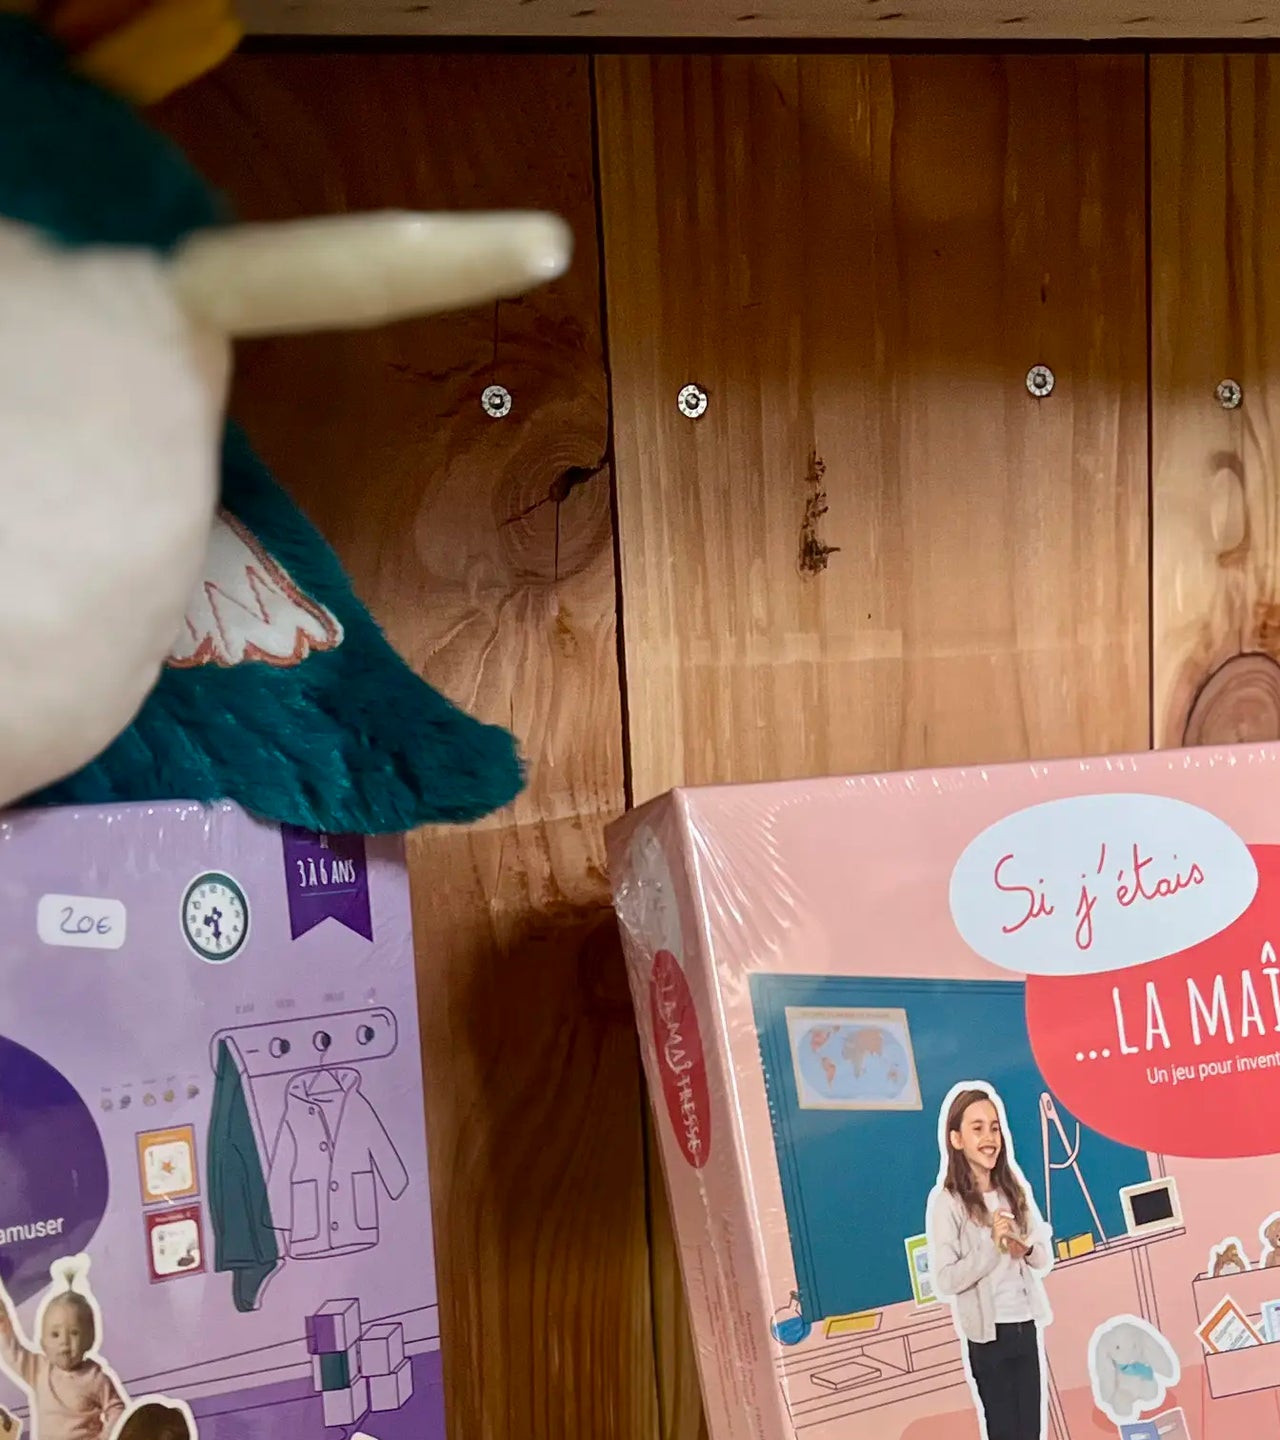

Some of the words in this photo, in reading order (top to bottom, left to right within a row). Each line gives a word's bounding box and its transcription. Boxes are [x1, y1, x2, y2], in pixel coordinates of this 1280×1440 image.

[296, 859, 307, 888] 3
[306, 857, 319, 887] À
[319, 857, 329, 886] 6
[331, 859, 357, 885] ANS
[993, 854, 1054, 933] Si
[1075, 842, 1205, 950] j'étais
[1146, 1065, 1169, 1085] Un
[1171, 1061, 1196, 1083] jeu
[1198, 1058, 1234, 1082] pour
